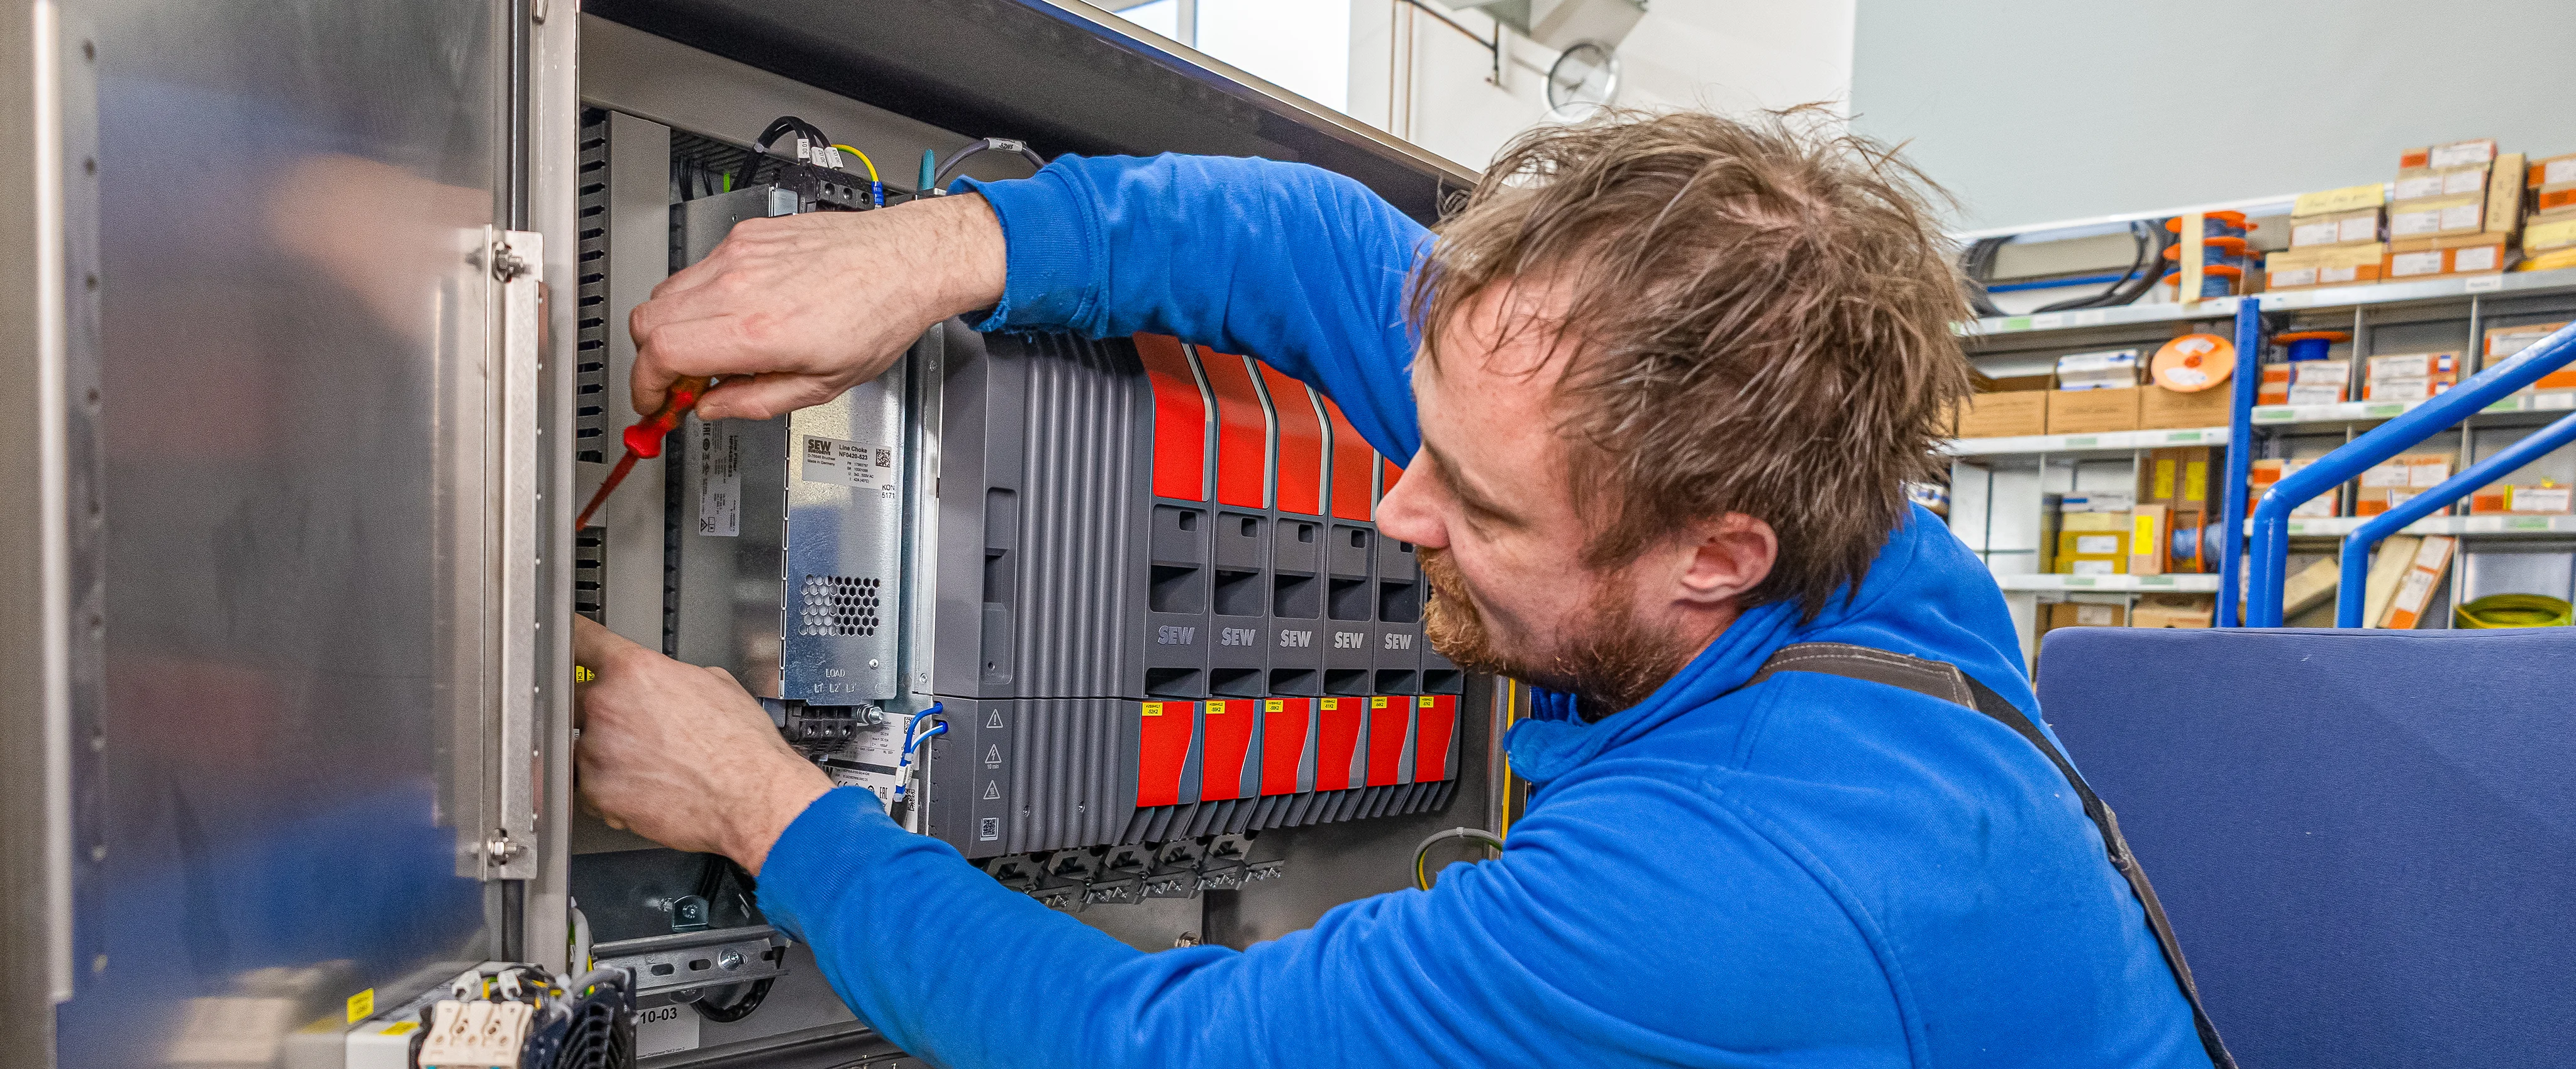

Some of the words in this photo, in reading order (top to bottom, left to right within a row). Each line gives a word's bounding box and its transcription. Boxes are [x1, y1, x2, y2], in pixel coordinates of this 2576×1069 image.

[808, 439, 831, 451] SEW
[838, 451, 868, 460] NF0420-523
[1158, 625, 1196, 645] SEW
[1221, 627, 1257, 646] SEW
[1280, 629, 1312, 648] SEW
[1334, 631, 1364, 648] SEW
[1384, 633, 1412, 650] SEW
[825, 668, 845, 678] LOAD
